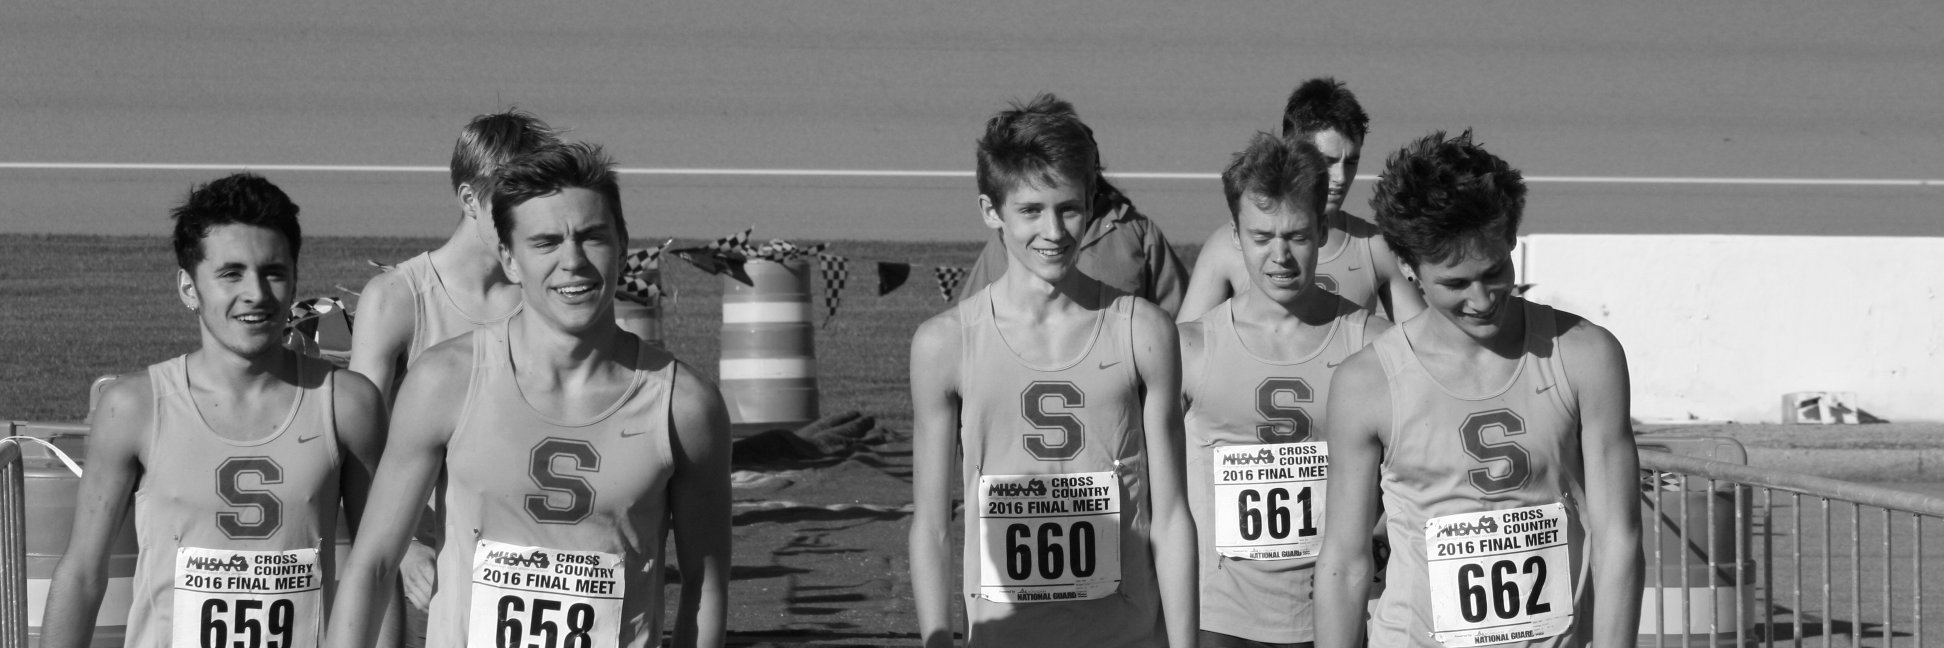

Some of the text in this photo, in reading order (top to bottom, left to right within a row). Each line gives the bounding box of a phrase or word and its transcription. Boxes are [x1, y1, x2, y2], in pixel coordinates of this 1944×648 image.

[1255, 377, 1314, 444] S
[1021, 381, 1085, 461] S
[1223, 450, 1271, 465] MHSAA
[1279, 445, 1317, 456] CROSS
[1459, 408, 1531, 495] S
[524, 437, 601, 525] S
[1223, 465, 1328, 481] 2016 FINAL MEE
[988, 481, 1043, 496] MHSAA
[1051, 476, 1094, 488] CROSS
[216, 456, 283, 540] S
[1052, 486, 1109, 498] COUNTRY
[988, 498, 1110, 514] 2016 FINAL MEET
[1238, 486, 1317, 541] 661
[1502, 509, 1544, 523] CROSS
[1504, 518, 1558, 535] COUNTRY
[1006, 521, 1096, 580] 660
[1437, 530, 1559, 556] 2016 FINAL MEET
[186, 555, 244, 571] MHSAA
[254, 554, 298, 564] CROSS
[556, 553, 600, 565] CROSS
[254, 564, 313, 575] COUNTRY
[555, 563, 614, 578] COUNTRY
[185, 575, 313, 590] 2016 FINAL MEET
[483, 568, 521, 585] 2016
[526, 573, 570, 590] FINAL
[576, 579, 616, 594] MEET
[1458, 556, 1551, 623] 662
[200, 598, 294, 648] 659
[496, 595, 594, 648] 658
[1474, 633, 1510, 644] NATIONAL
